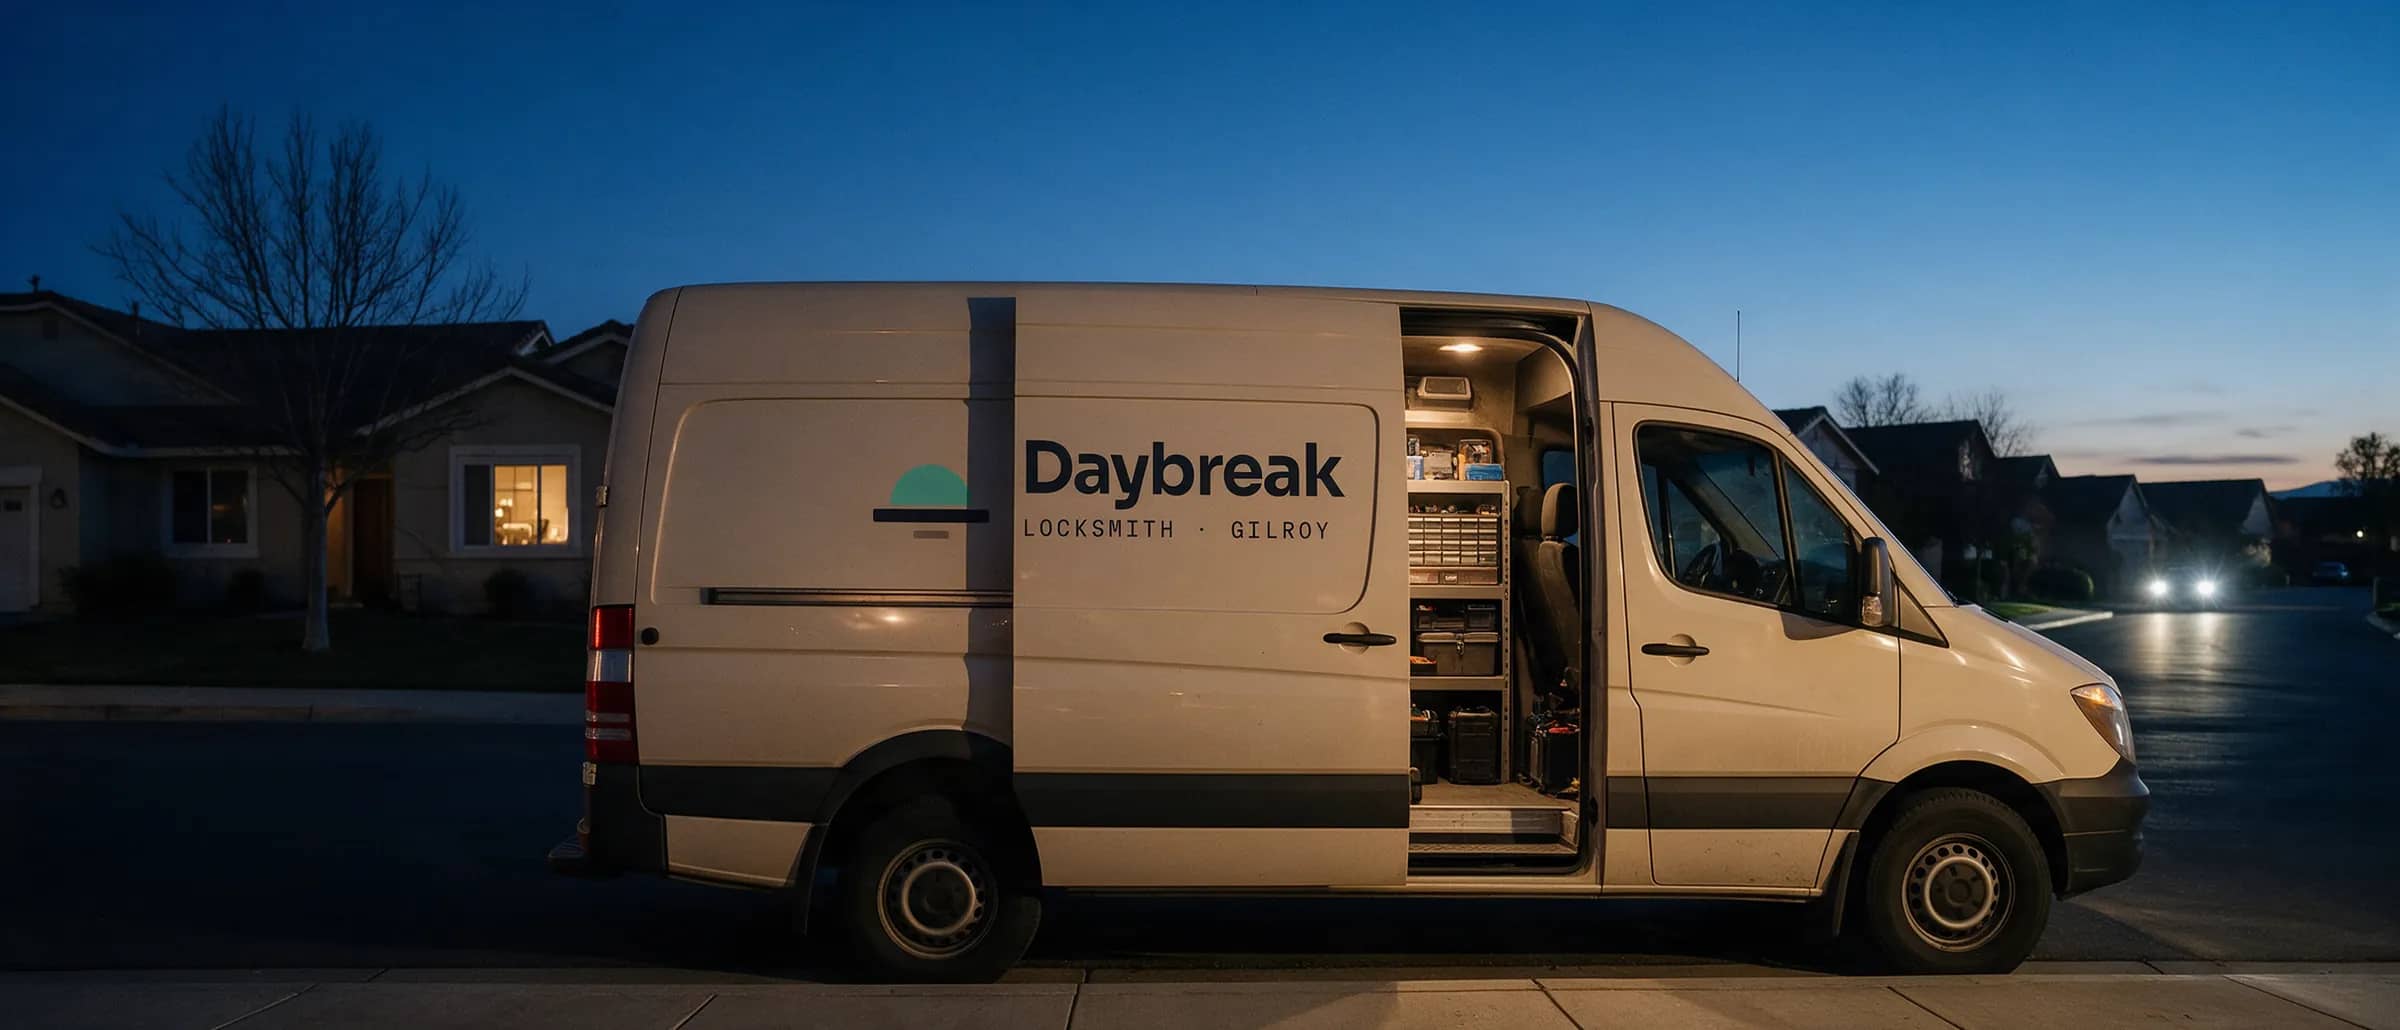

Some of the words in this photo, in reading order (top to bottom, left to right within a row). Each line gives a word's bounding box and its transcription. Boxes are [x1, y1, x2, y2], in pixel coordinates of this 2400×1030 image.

[1025, 440, 1345, 510] Daybreak
[1024, 519, 1173, 538] LOCKSMITH
[1231, 521, 1328, 539] GILROY
